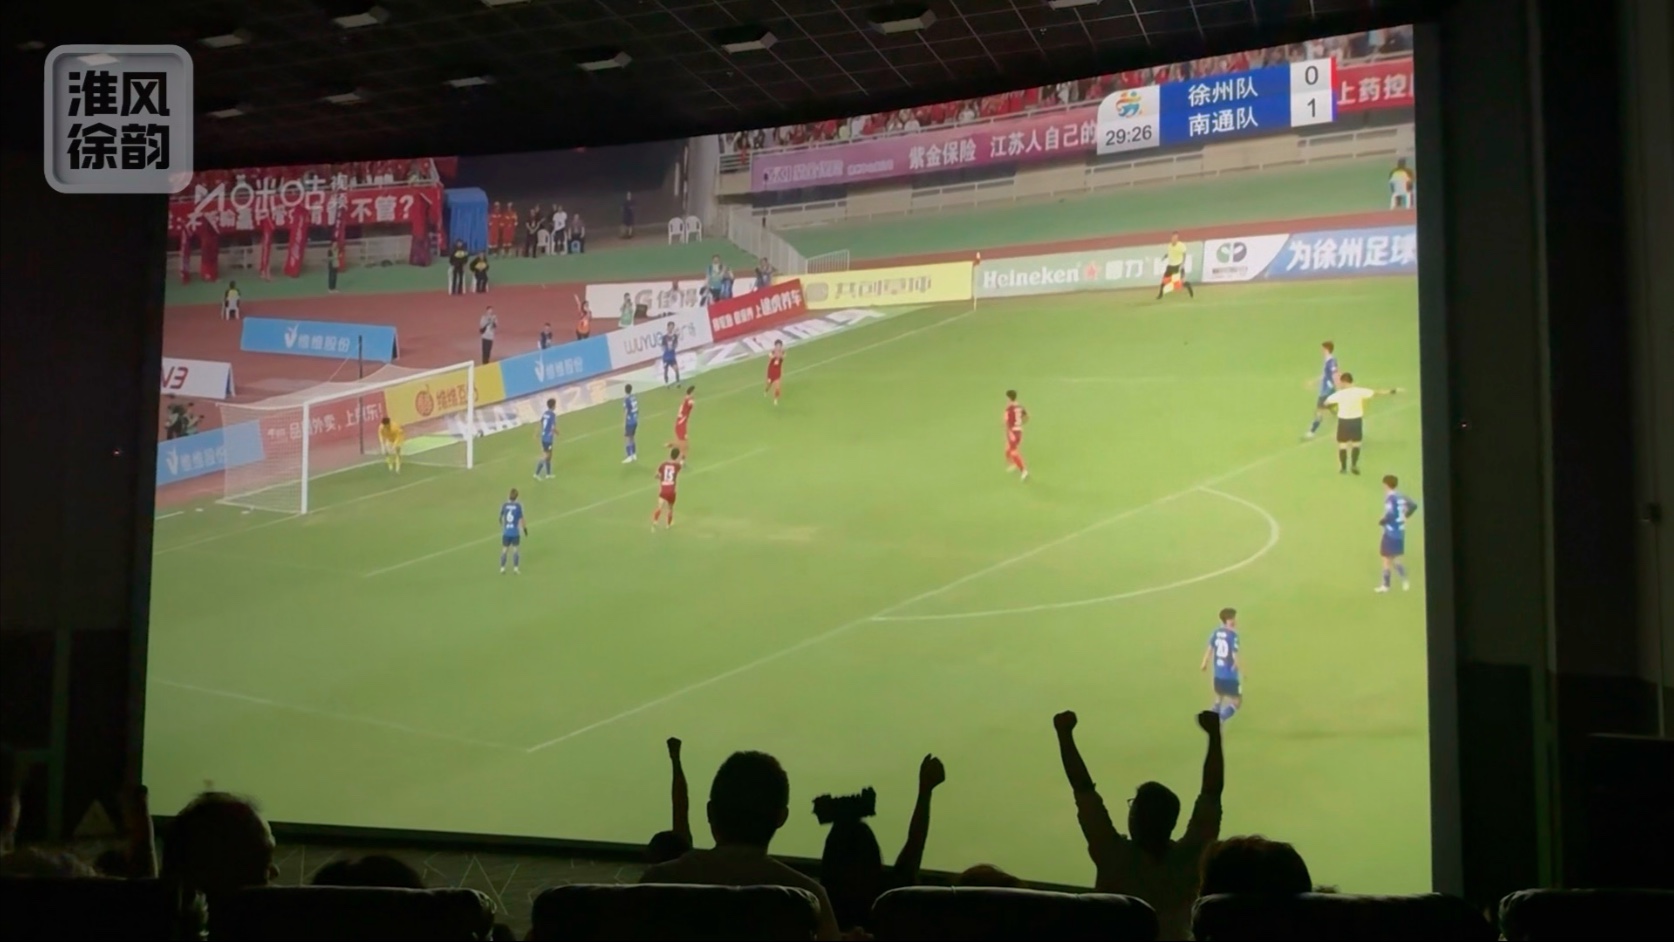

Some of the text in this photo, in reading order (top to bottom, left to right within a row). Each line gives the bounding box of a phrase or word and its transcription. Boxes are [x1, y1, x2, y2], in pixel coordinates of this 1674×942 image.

[1304, 65, 1319, 86] 0
[1188, 76, 1258, 108] 徐州队
[1337, 72, 1413, 105] 上药控
[1307, 98, 1317, 118] 1
[1188, 106, 1258, 137] 南通队
[908, 138, 976, 170] 紫金保险
[990, 121, 1097, 158] 江苏人自己的
[1106, 125, 1152, 146] 29:26
[1286, 233, 1416, 272] 为徐州足球
[983, 263, 1080, 288] Heineken
[506, 509, 514, 523] 6
[1214, 638, 1229, 659] 20
